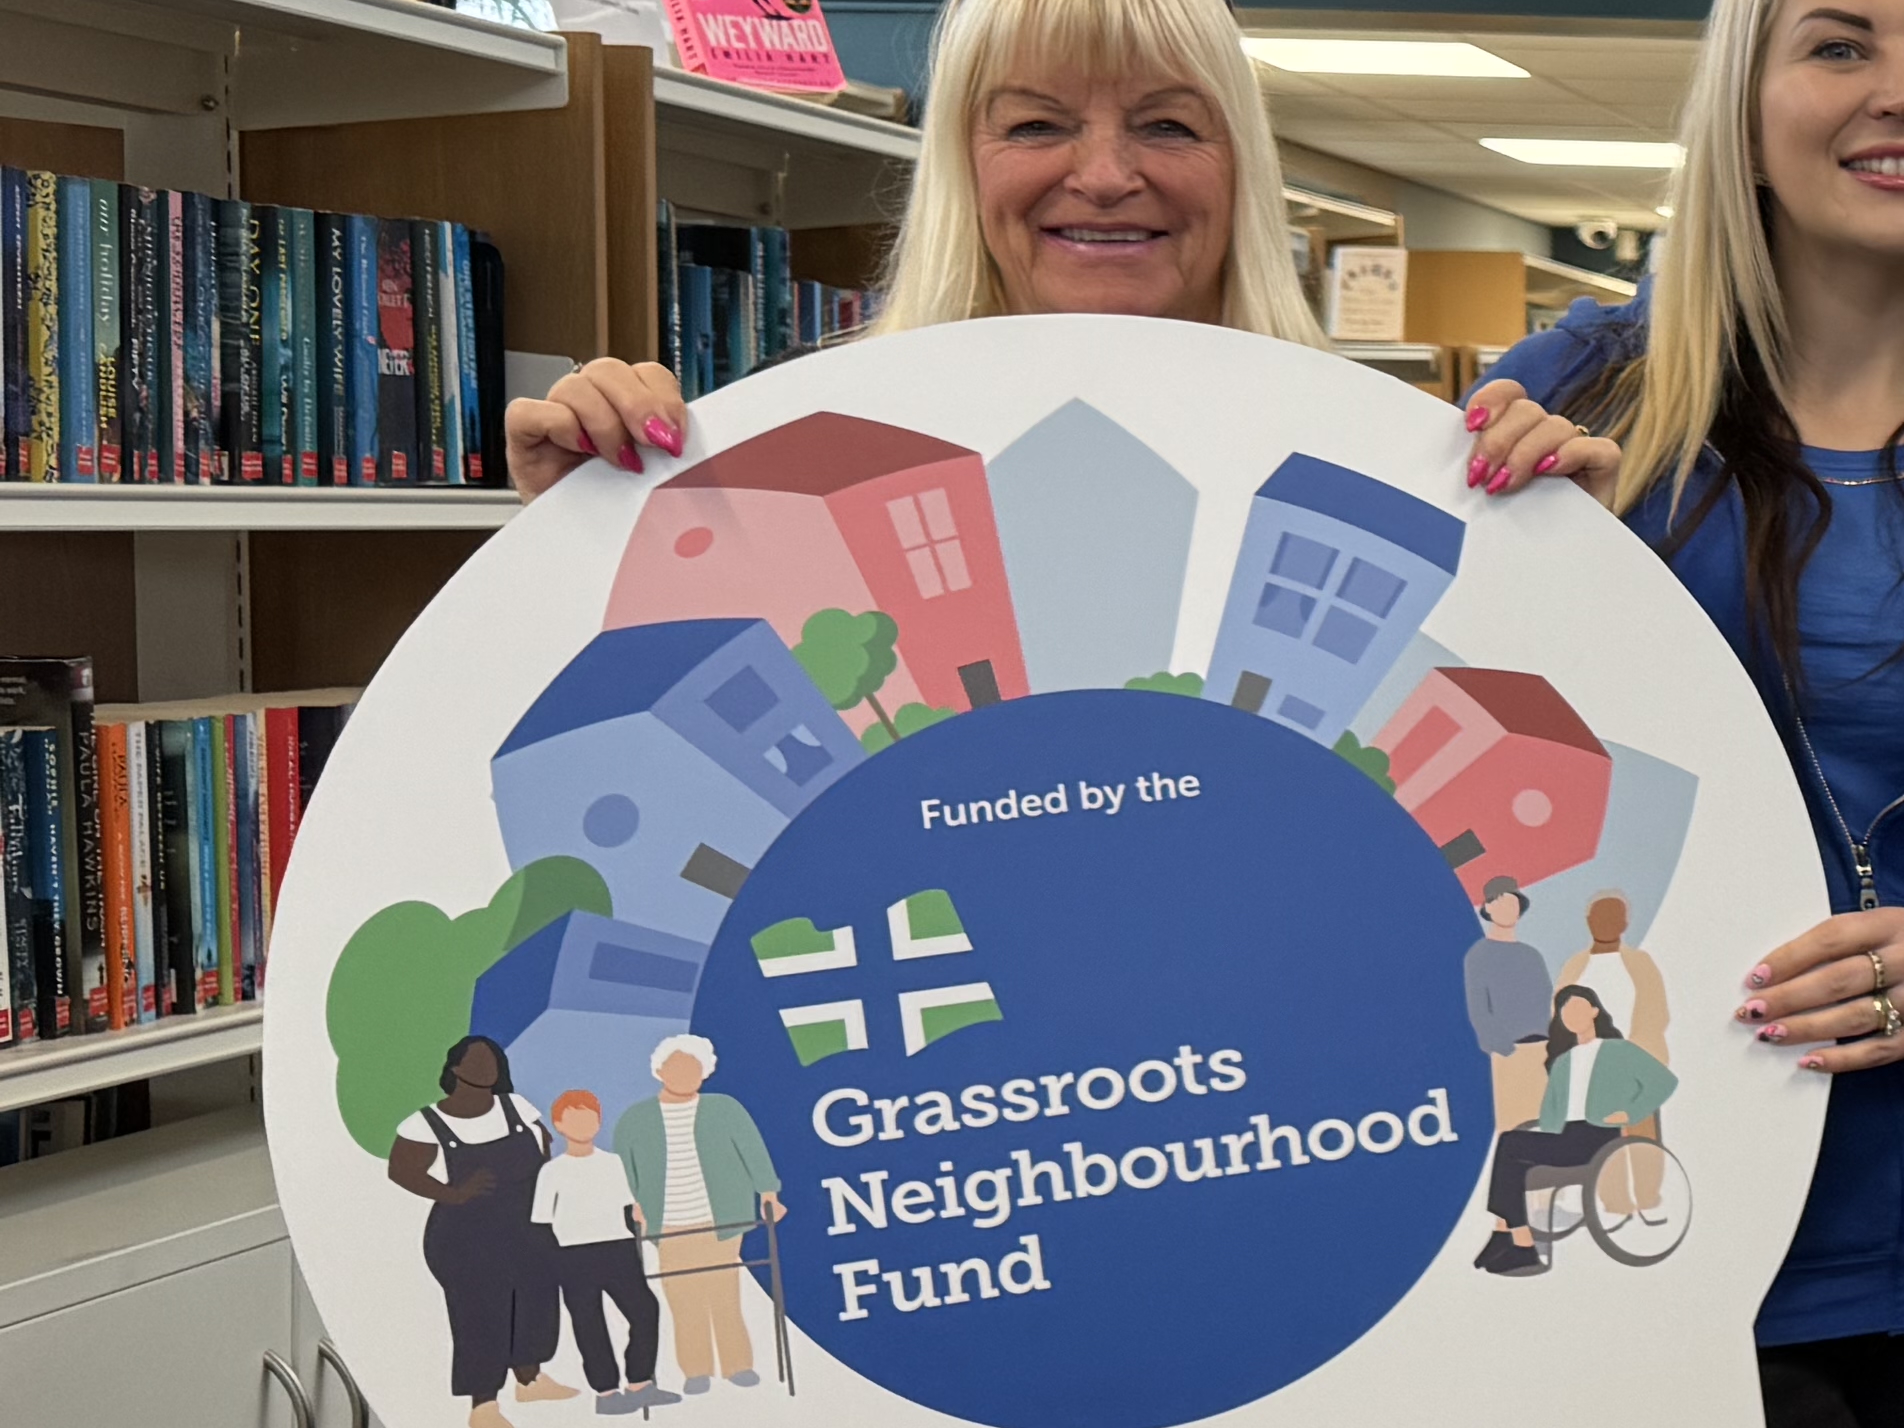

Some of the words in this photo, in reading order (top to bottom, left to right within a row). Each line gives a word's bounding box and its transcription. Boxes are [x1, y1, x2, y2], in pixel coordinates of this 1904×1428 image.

[697, 12, 829, 52] WEYWARD
[248, 218, 260, 275] DAY
[331, 227, 343, 261] MY
[99, 242, 114, 323] holiday
[249, 285, 261, 347] ONE
[331, 266, 343, 340] LOVELY
[332, 344, 345, 396] WIFE
[79, 732, 92, 807] PAULA
[920, 784, 1070, 830] Funded
[1079, 776, 1127, 814] by
[1135, 771, 1201, 806] the
[83, 821, 98, 932] HAWKINS
[811, 1042, 1248, 1148] Grassroots
[820, 1088, 1459, 1237] Neighbourhood
[832, 1234, 1052, 1321] Fund
